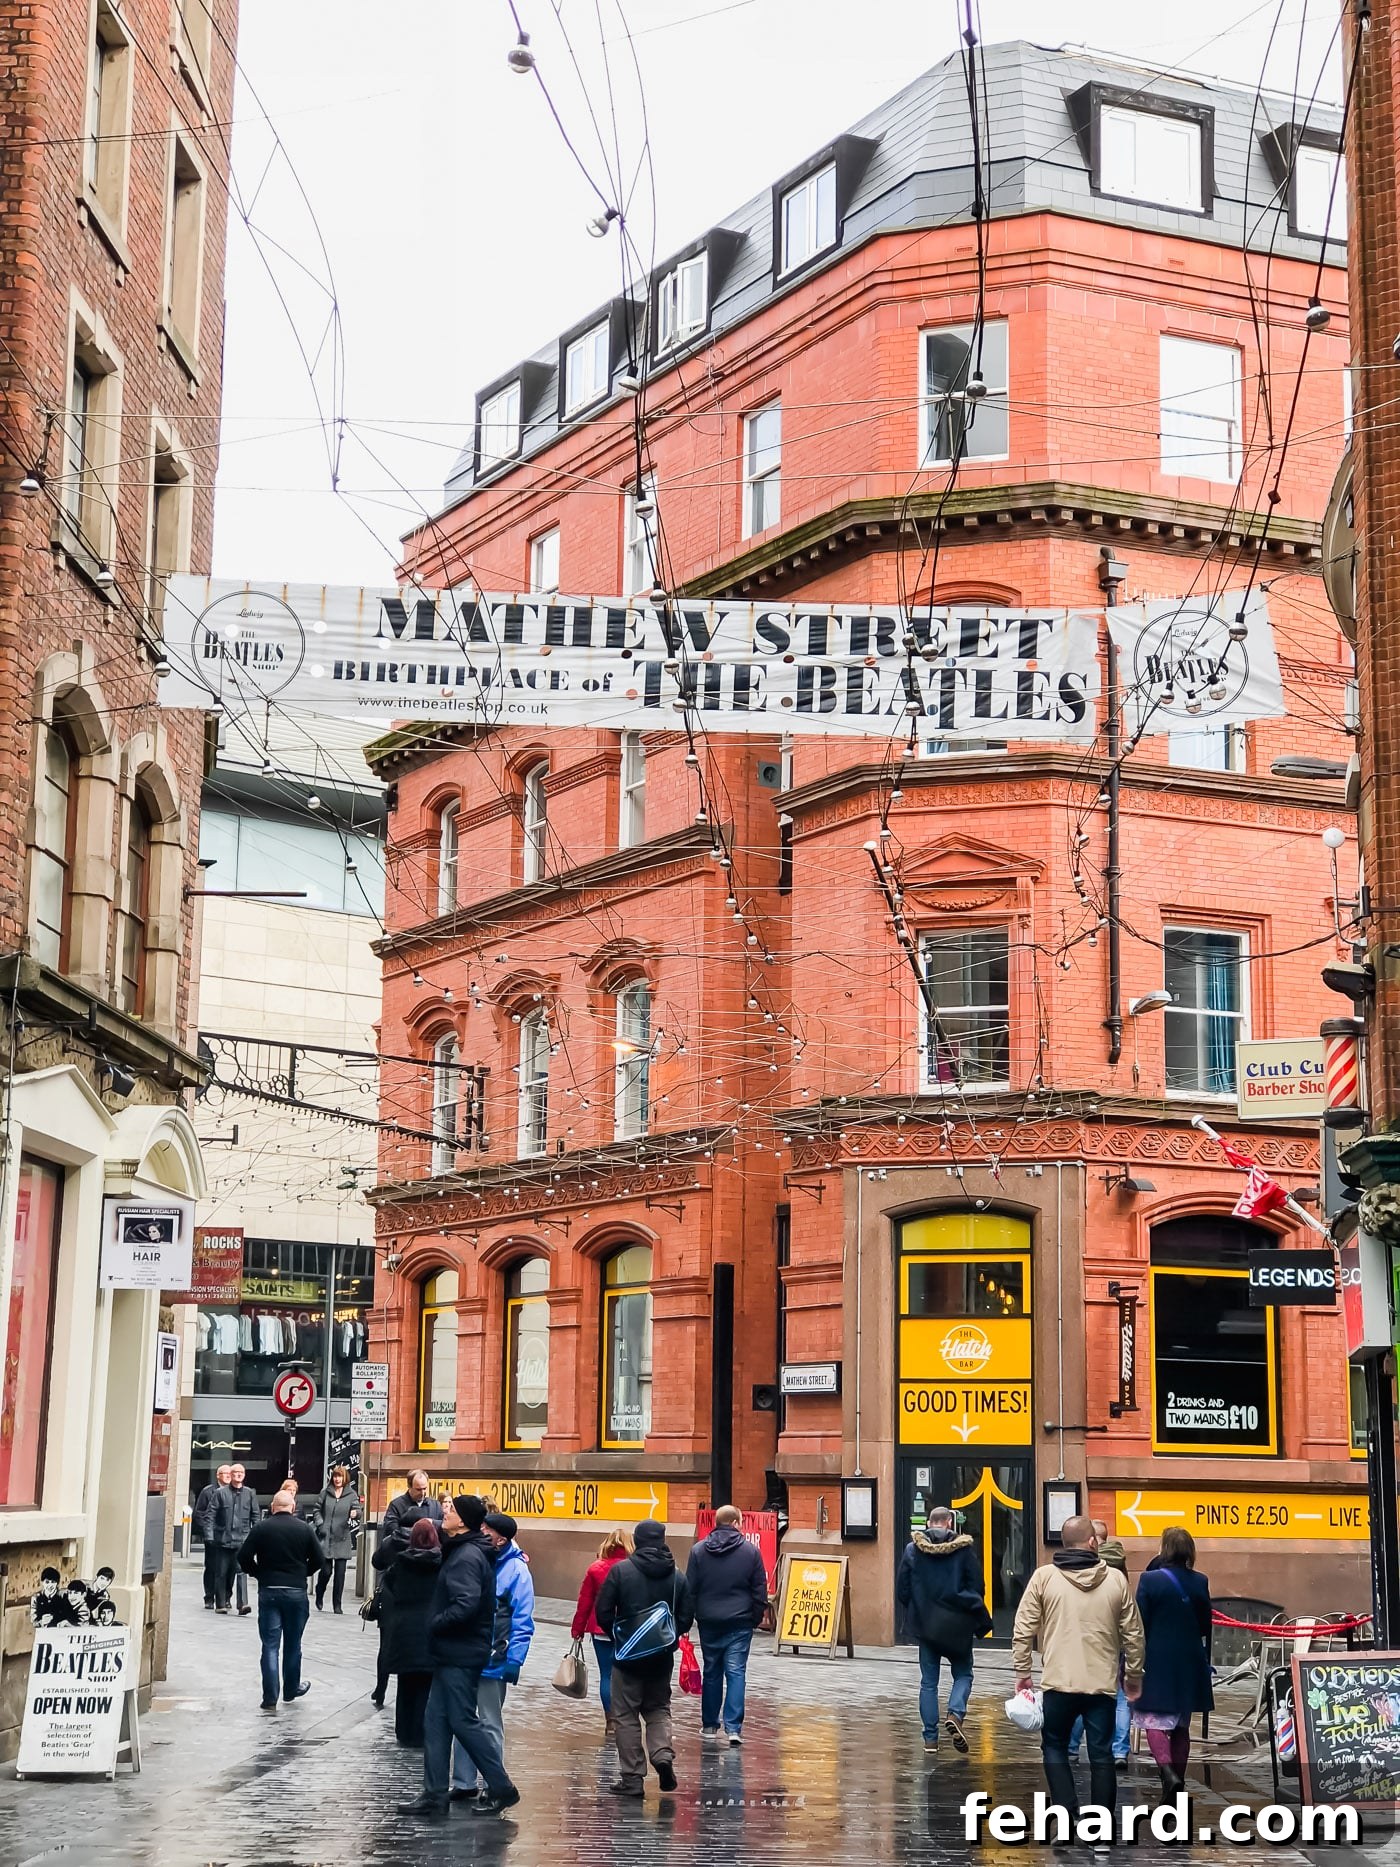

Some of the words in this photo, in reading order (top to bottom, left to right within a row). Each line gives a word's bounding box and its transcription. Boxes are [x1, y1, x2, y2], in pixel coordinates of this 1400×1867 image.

[371, 597, 730, 652] MATHEW
[752, 611, 1054, 660] STREET
[203, 630, 285, 666] BEATLES
[333, 660, 569, 690] BIRTHPLACE
[582, 672, 613, 692] of
[633, 660, 767, 712] THE
[791, 664, 1088, 730] BEATLES
[358, 697, 548, 715] www.thebeatleshop.co.uk
[1246, 1061, 1292, 1077] Club
[1300, 1060, 1325, 1075] Cu
[1247, 1082, 1295, 1096] Barber
[1299, 1080, 1325, 1094] Sho
[203, 1236, 241, 1249] ROCKS
[133, 1252, 161, 1261] HAIR
[203, 1258, 240, 1269] Beauty
[1249, 1268, 1335, 1287] LEGENDS
[207, 1285, 239, 1293] SPECIALISTS
[939, 1339, 993, 1358] Hatch
[786, 1376, 807, 1385] MATHEW
[809, 1375, 827, 1384] STREET
[904, 1390, 957, 1413] GOOD
[962, 1390, 1027, 1413] TIMES!
[1168, 1392, 1175, 1408] 2
[1177, 1398, 1206, 1408] DRINKS
[1208, 1398, 1225, 1408] AND
[1168, 1413, 1191, 1425] TWO
[1194, 1413, 1226, 1426] MAINS
[1230, 1405, 1258, 1430] £10
[502, 1483, 545, 1513] DRINKS
[574, 1484, 599, 1515] £10!
[758, 1514, 775, 1531] LIKE
[1196, 1504, 1239, 1525] PINTS
[1247, 1505, 1289, 1526] £2.50
[1329, 1507, 1361, 1526] LIVE
[793, 1588, 799, 1599] 2
[802, 1589, 831, 1601] MEALS
[791, 1600, 797, 1611] 2
[799, 1600, 831, 1612] DRINKS
[788, 1613, 828, 1638] £10!
[68, 1635, 97, 1644] THE
[84, 1638, 123, 1651] ORIGINAL
[33, 1643, 124, 1680] BEATLES
[33, 1696, 72, 1715] OPEN
[75, 1696, 113, 1714] NOW
[1315, 1704, 1371, 1726] Live
[65, 1722, 92, 1731] largest
[68, 1750, 90, 1758] world
